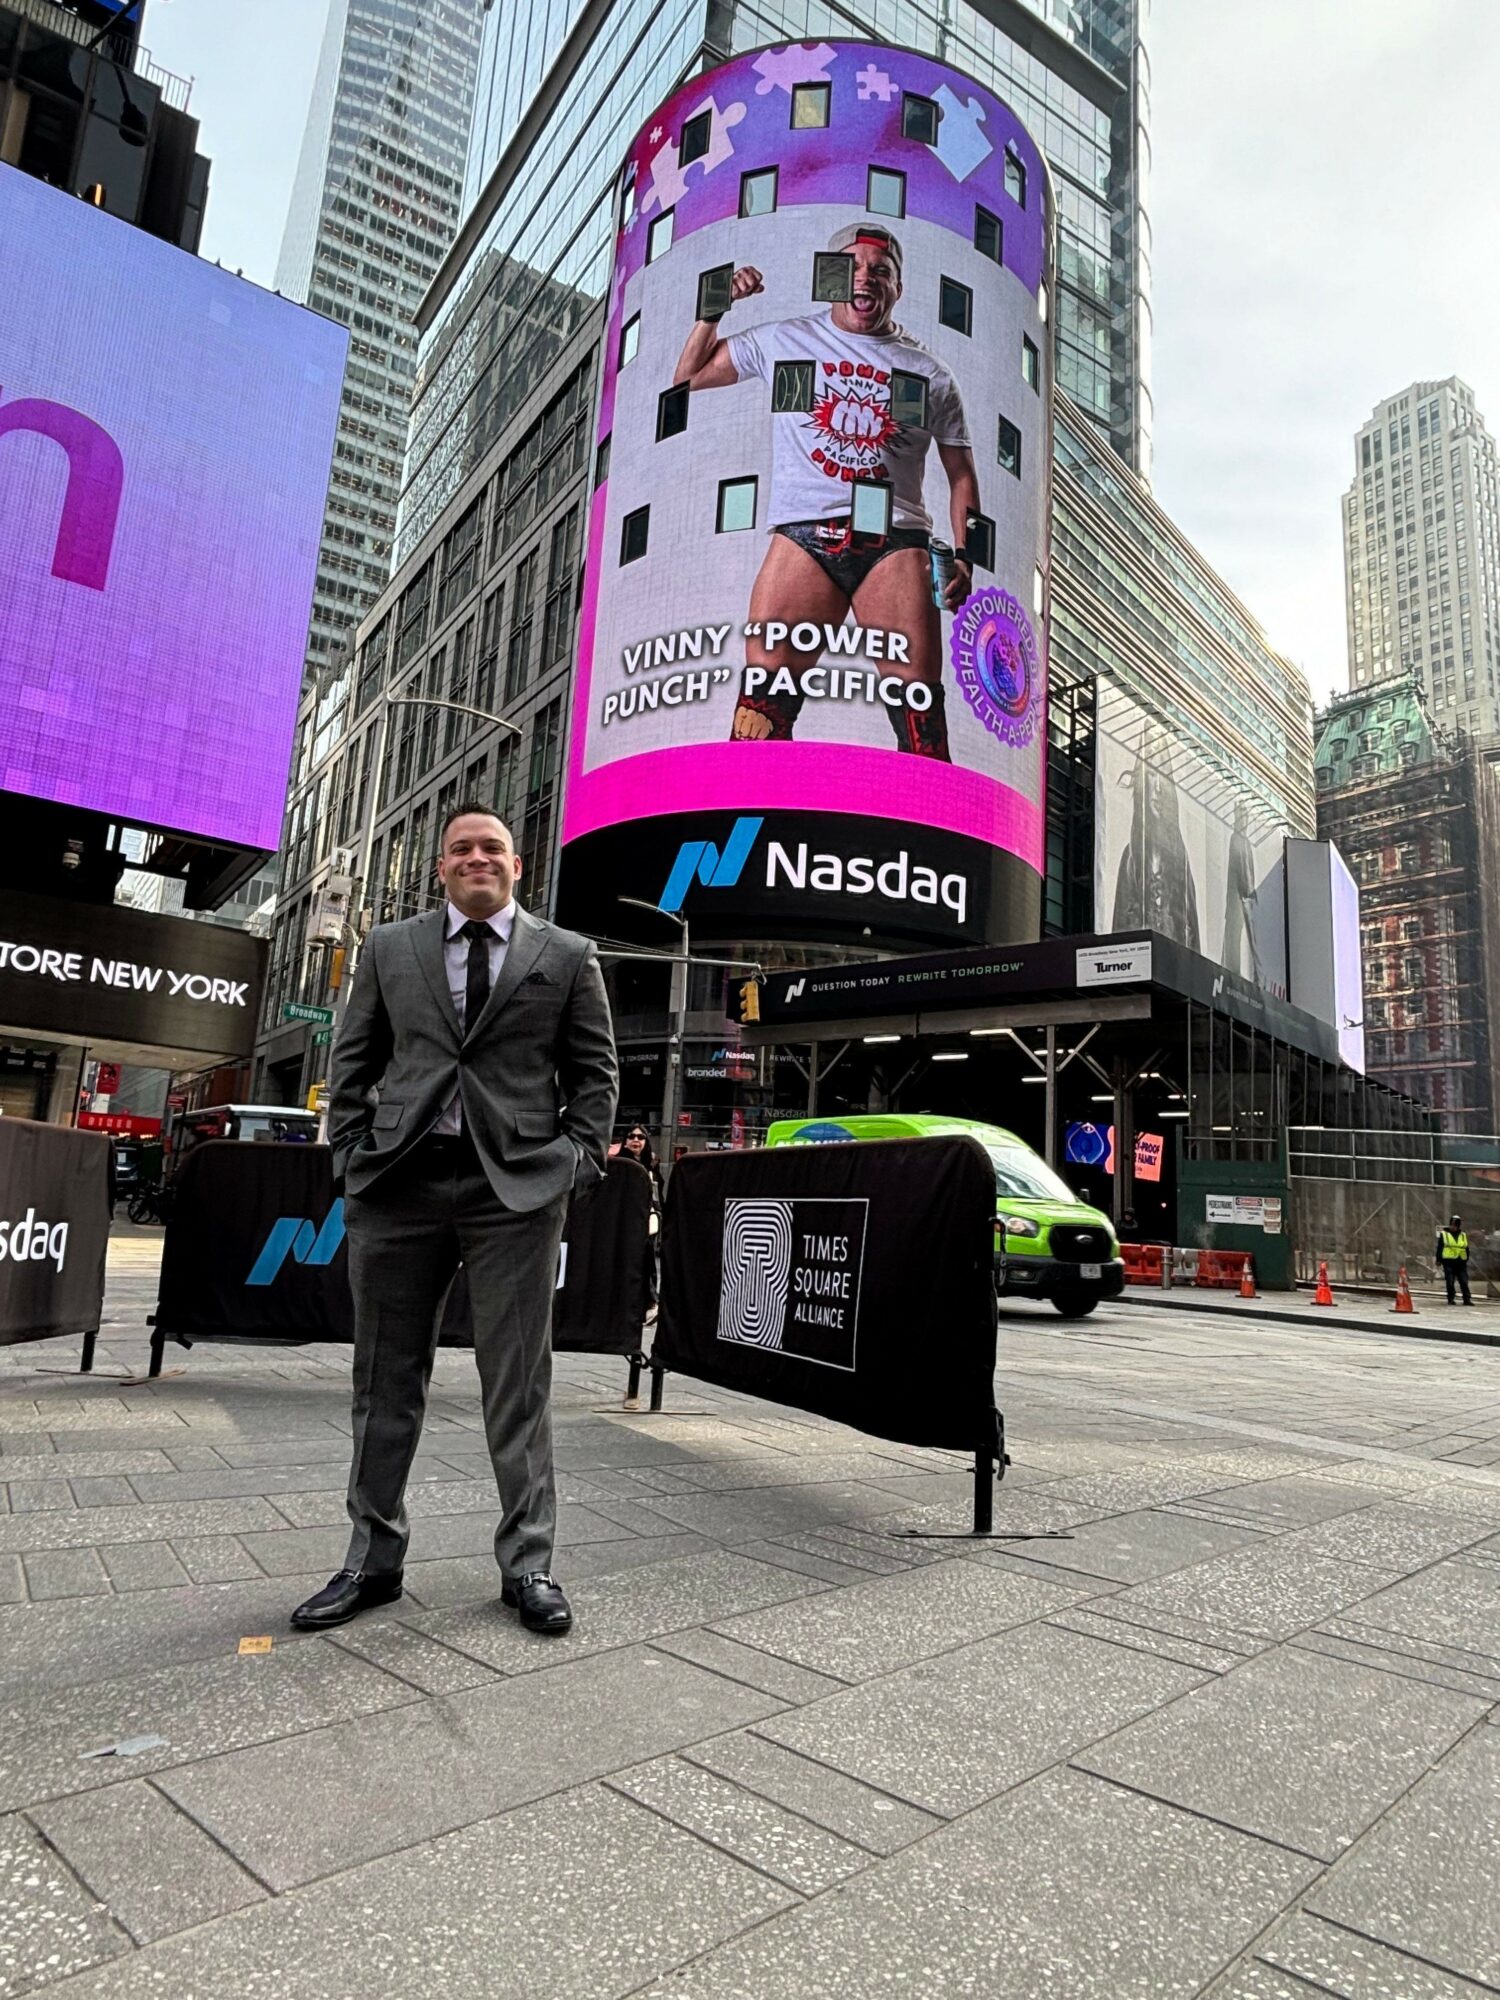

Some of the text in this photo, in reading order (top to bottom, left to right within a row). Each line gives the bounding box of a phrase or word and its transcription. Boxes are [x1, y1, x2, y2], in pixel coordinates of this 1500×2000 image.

[823, 361, 892, 389] POWE
[840, 378, 883, 395] VINNY
[824, 446, 878, 466] PACIFICO
[959, 594, 1034, 653] EMPOWERED
[624, 622, 911, 673] VINNY “POWER
[603, 668, 932, 724] PUNCH” PACIFICO
[766, 842, 966, 924] Nasdaq
[1094, 962, 1133, 973] Turner
[90, 958, 162, 992] NEW
[167, 970, 249, 1006] YORK
[812, 979, 856, 992] QUESTION
[860, 976, 890, 987] TODAY
[898, 970, 947, 983] REWRITE
[290, 1005, 328, 1024] Broadway
[726, 1051, 755, 1061] Nasdaq
[687, 1068, 726, 1078] branded
[803, 1235, 848, 1262] TIMES
[794, 1267, 851, 1299] SQUARE
[794, 1303, 844, 1329] ALLIANCE
